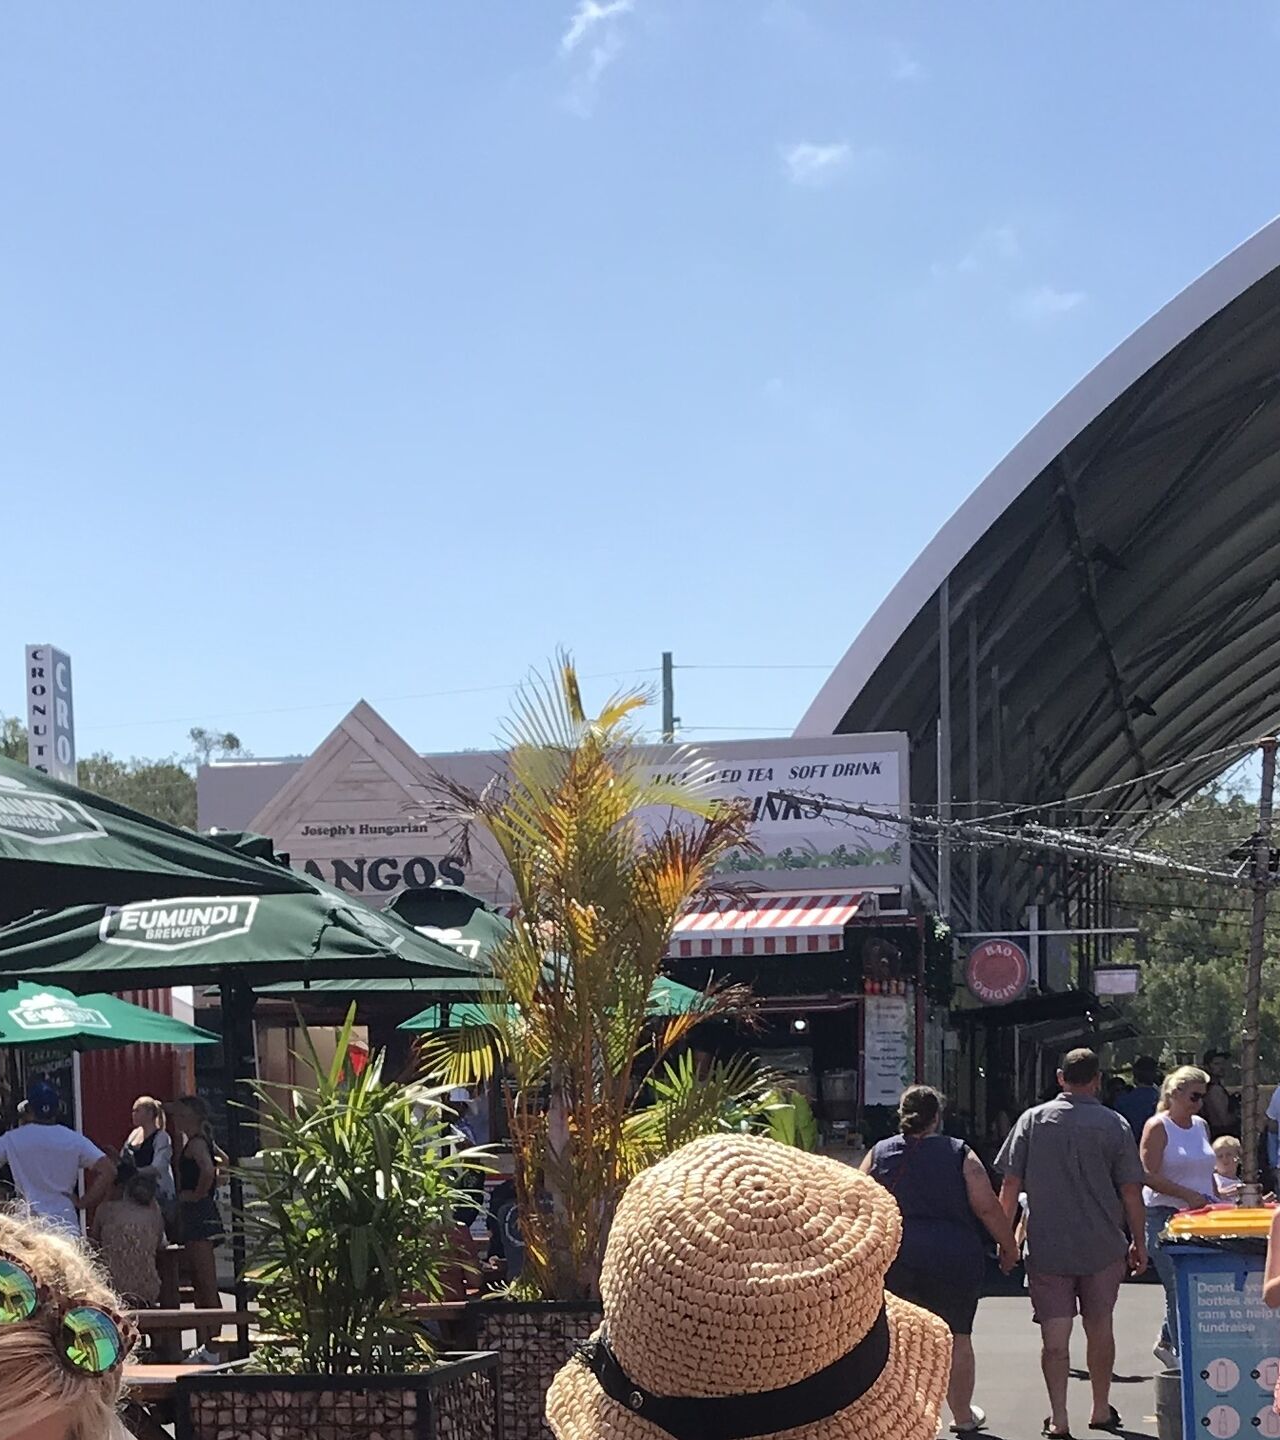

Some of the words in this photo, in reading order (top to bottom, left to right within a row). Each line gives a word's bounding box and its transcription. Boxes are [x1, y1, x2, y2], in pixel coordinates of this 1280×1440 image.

[31, 650, 49, 774] CRONUTS
[747, 768, 773, 782] TEA
[788, 764, 829, 780] SOFT
[832, 761, 882, 778] DRINK
[301, 824, 355, 838] Joseph's
[359, 823, 428, 836] Hungarian
[120, 904, 238, 931] EUMUNDI
[145, 925, 211, 940] BREWERY
[985, 944, 1012, 957] BAO
[973, 980, 1016, 999] ORIGIN
[1197, 1282, 1236, 1293] Donat
[1197, 1296, 1241, 1306] bottles
[1197, 1310, 1226, 1319] cans
[1230, 1309, 1243, 1319] to
[1246, 1308, 1273, 1320] help
[1197, 1321, 1256, 1333] fundraise
